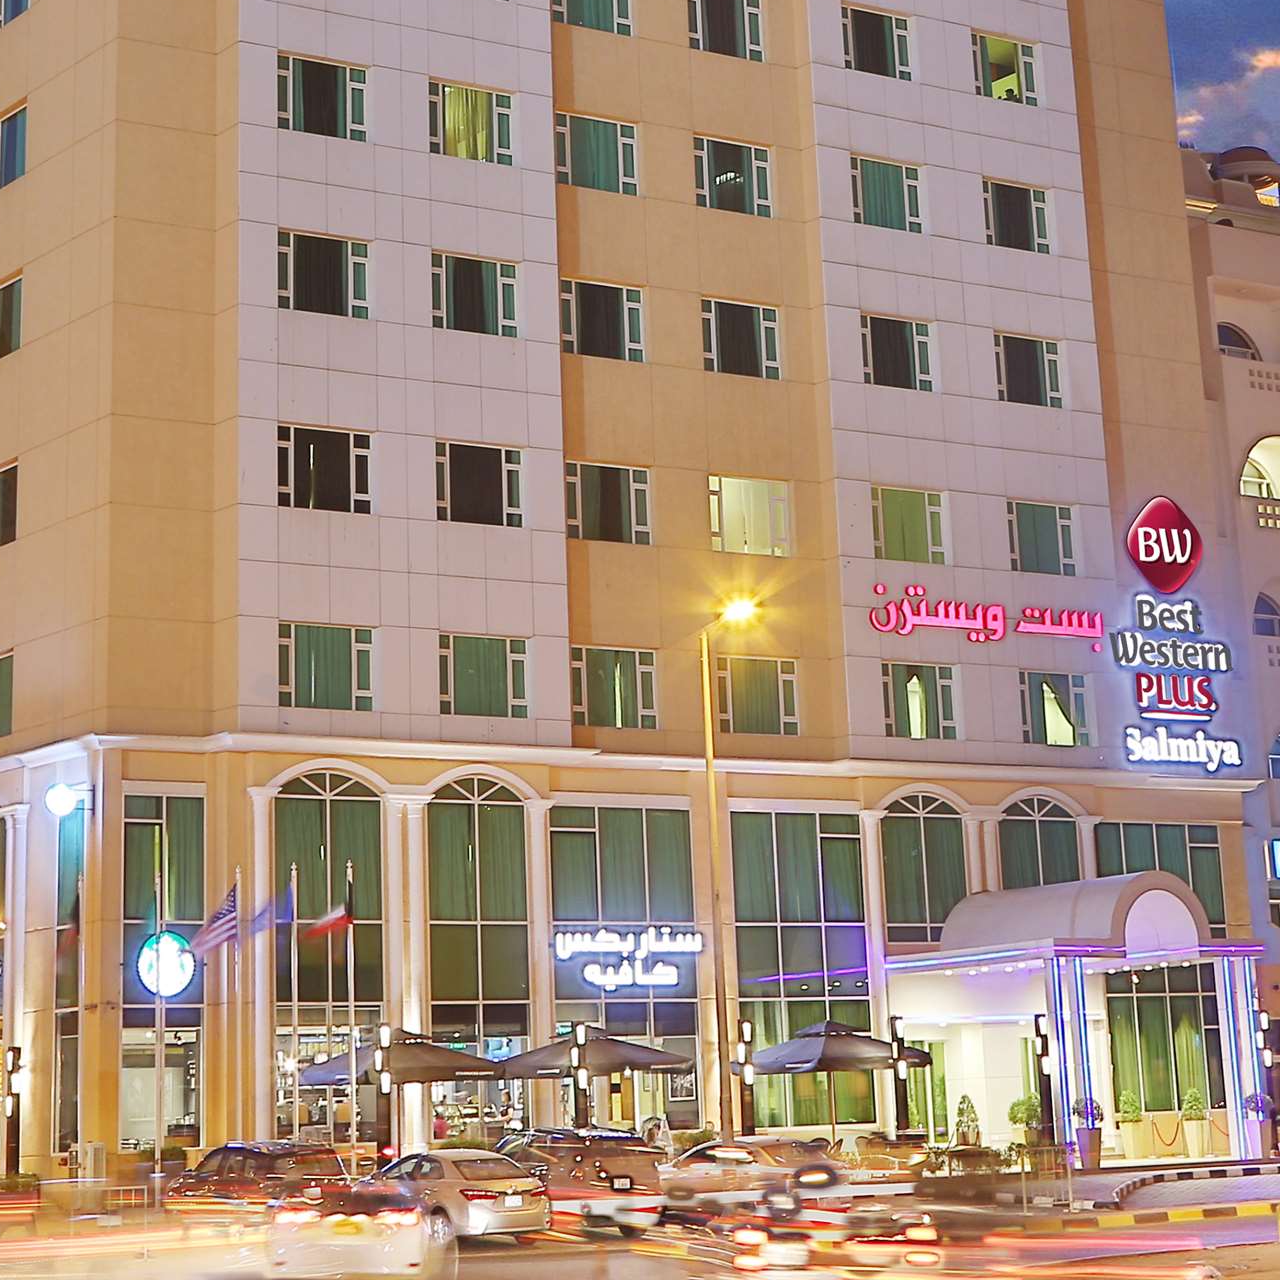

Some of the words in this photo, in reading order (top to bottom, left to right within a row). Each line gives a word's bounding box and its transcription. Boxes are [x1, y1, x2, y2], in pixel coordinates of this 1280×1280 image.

[1137, 526, 1194, 564] BW
[1015, 606, 1104, 654] بست
[1136, 597, 1202, 634] Best
[1110, 631, 1232, 672] Western
[1136, 673, 1216, 710] PLUS
[1126, 726, 1242, 773] Salmiya
[583, 960, 678, 992] كافيه
